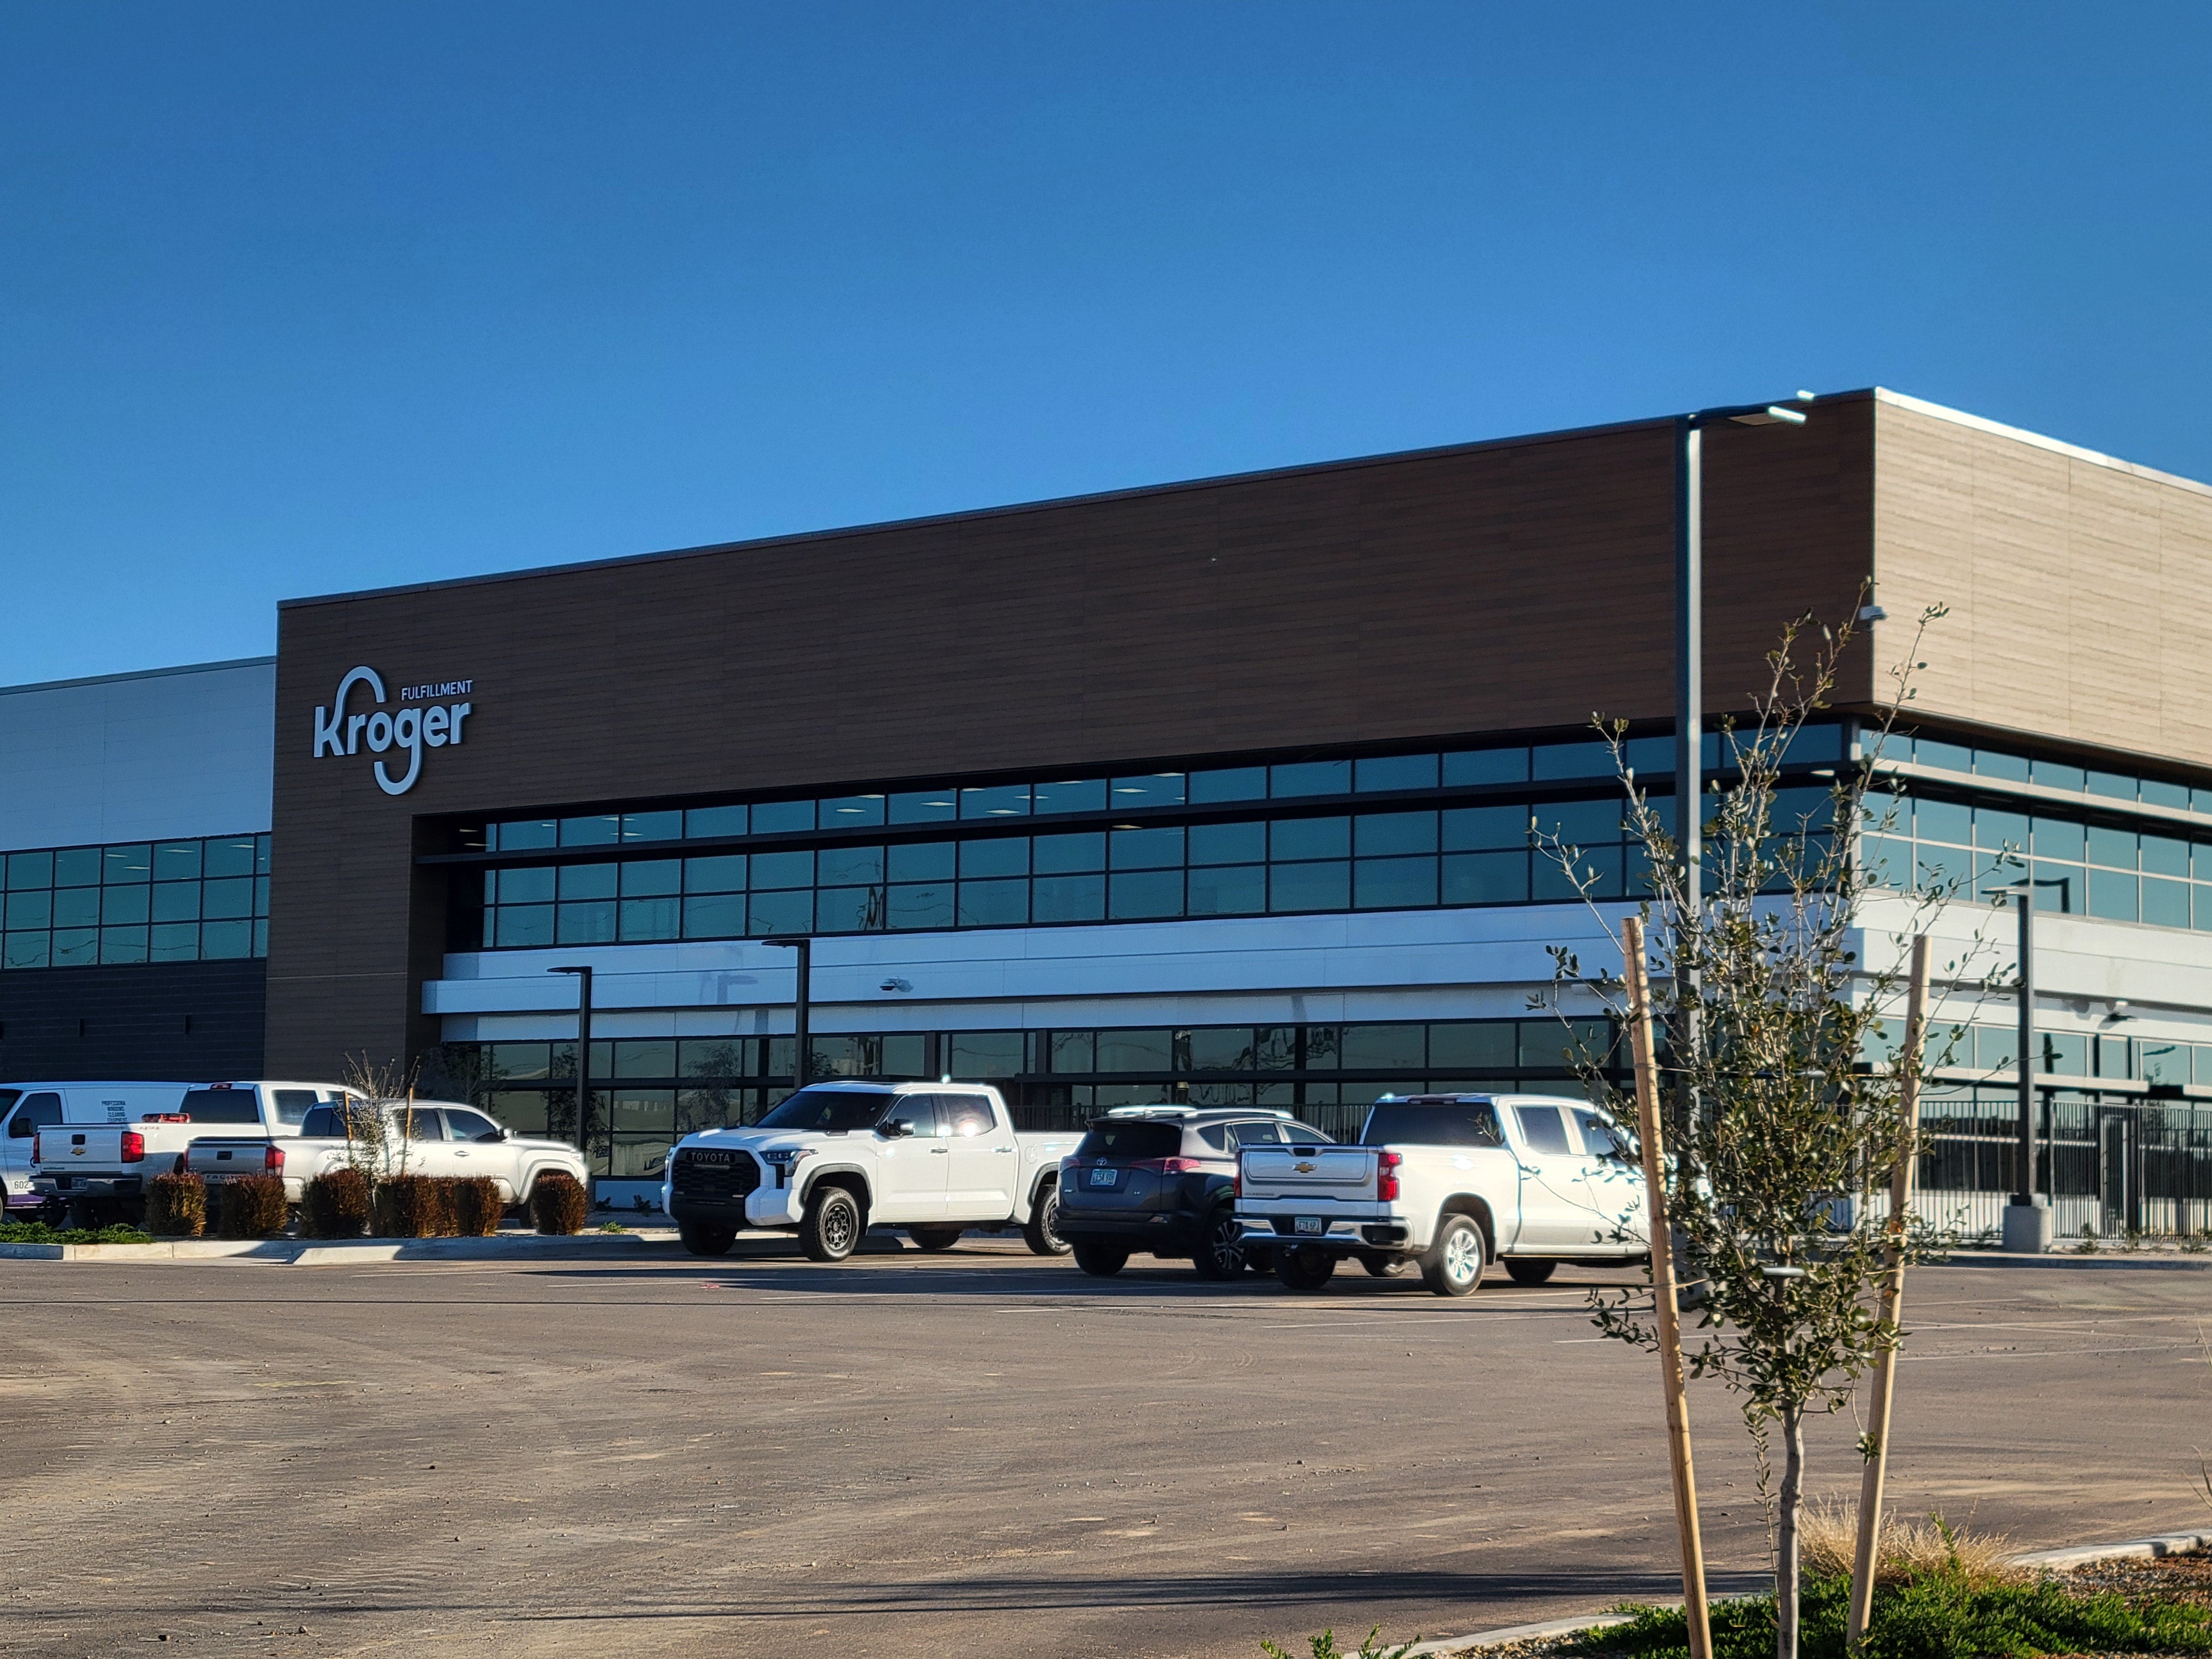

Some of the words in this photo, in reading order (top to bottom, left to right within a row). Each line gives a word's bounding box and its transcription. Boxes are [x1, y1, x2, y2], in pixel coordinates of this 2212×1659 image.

[401, 680, 473, 701] FULFILLMENT
[313, 665, 472, 795] Kroger
[691, 1152, 730, 1163] TOYOTA
